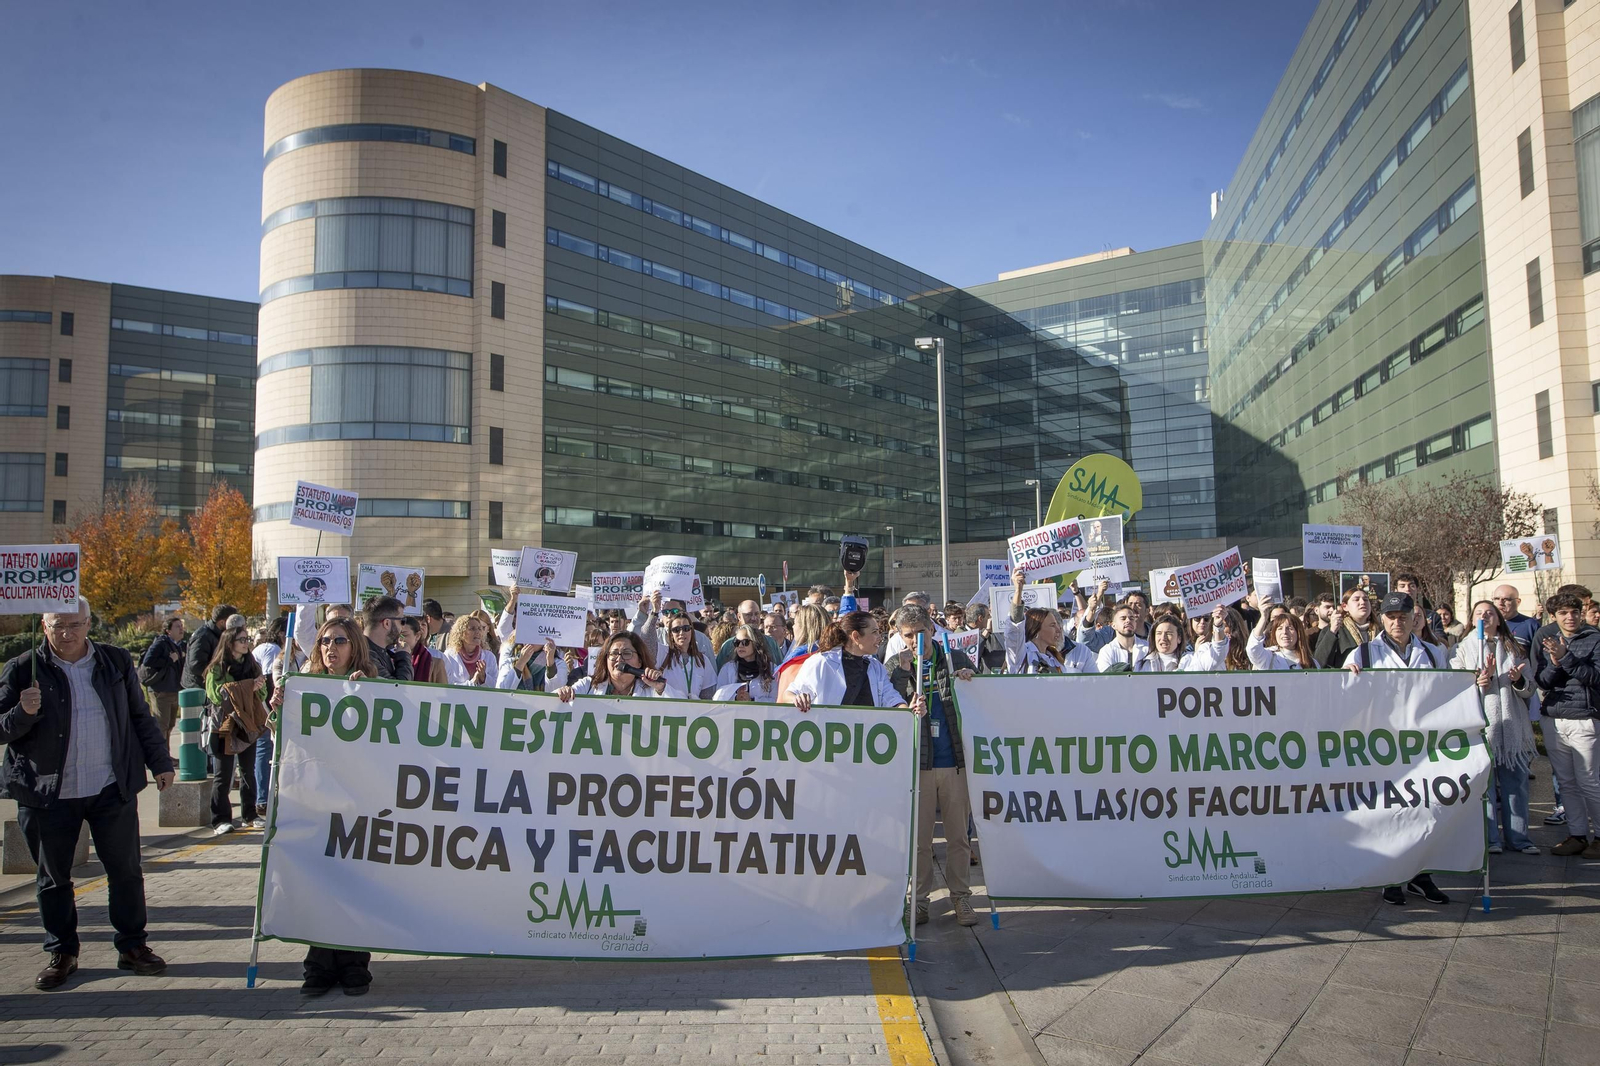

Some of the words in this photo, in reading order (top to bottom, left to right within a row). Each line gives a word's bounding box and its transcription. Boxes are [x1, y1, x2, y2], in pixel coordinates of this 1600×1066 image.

[297, 486, 330, 502] ESTATUTO
[332, 493, 355, 506] MARCO
[1069, 468, 1130, 509] SMA
[296, 497, 354, 516] PROPIO
[297, 508, 352, 526] FACULTATIVAS/OS
[1011, 532, 1049, 554] ESTATUTO
[1050, 523, 1080, 540] MARCO
[1015, 536, 1083, 563] PROPIO
[41, 552, 76, 568] MARCO
[1020, 548, 1086, 572] FACULTATIVAS/OS
[1178, 564, 1216, 586] ESTATUTO
[1216, 552, 1240, 571] MARCO
[594, 577, 621, 586] ESTATUTO
[1182, 566, 1242, 597] PROPIO
[1189, 578, 1244, 607] FACULTATIVAS/OS
[597, 594, 642, 602] FACULTATIVAS/OS
[538, 626, 560, 634] SMA
[1157, 686, 1223, 718] POR
[1232, 686, 1276, 716] UN
[301, 692, 404, 744] POR
[417, 702, 488, 749] UN
[500, 708, 719, 759] ESTATUTO
[732, 718, 898, 765] PROPIO
[972, 734, 1158, 776] ESTATUTO
[1168, 730, 1306, 772] MARCO
[1317, 728, 1470, 768] PROPIO
[396, 764, 460, 812] DE
[474, 768, 532, 814] LA
[546, 768, 796, 820] PROFESIÓN
[982, 790, 1067, 823] PARA
[1074, 786, 1178, 821] LAS/OS
[1188, 773, 1471, 818] FACULTATIVAS/OS
[324, 808, 511, 872] MÉDICA
[526, 828, 555, 873] Y
[568, 829, 866, 875] FACULTATIVA
[1163, 826, 1258, 872] SMA
[1232, 879, 1273, 889] Granada
[527, 878, 640, 931] SMA
[528, 930, 566, 939] Sindicato
[569, 931, 599, 940] Médico
[602, 932, 635, 941] Andaluz
[601, 941, 649, 952] Granada
